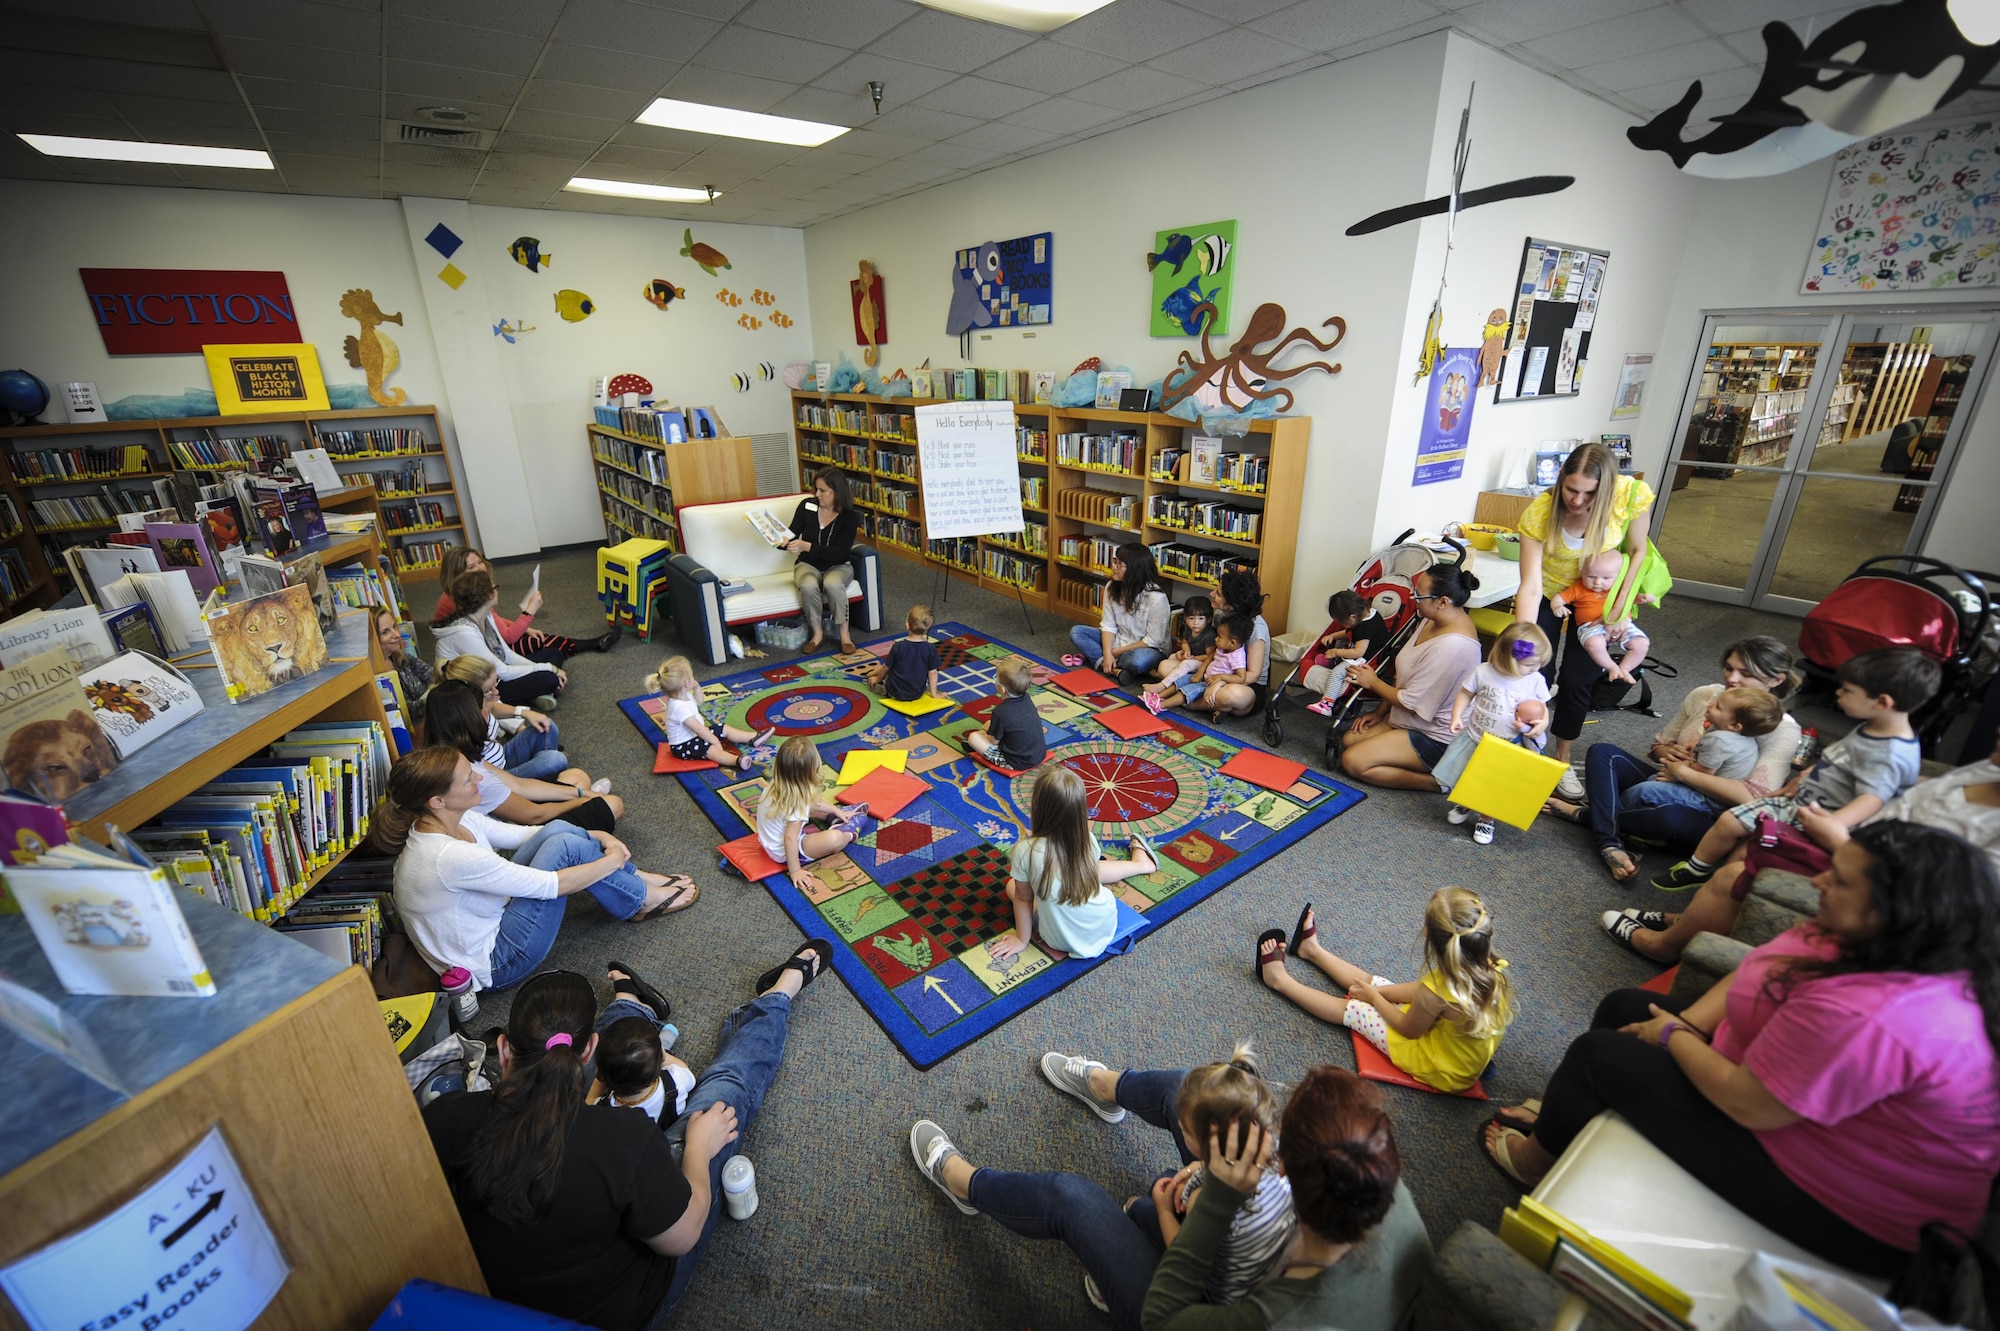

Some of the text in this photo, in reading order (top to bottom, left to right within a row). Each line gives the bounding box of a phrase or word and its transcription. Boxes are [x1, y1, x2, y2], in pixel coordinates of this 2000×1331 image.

[1000, 240, 1031, 258] READ
[1010, 273, 1050, 290] BOOKS
[89, 293, 296, 326] FICTION
[235, 363, 295, 372] CELEBRATE
[1438, 355, 1457, 376] Spanish
[1458, 354, 1470, 365] Story
[249, 372, 288, 380] BLACK
[251, 380, 296, 389] HISTORY
[252, 388, 292, 397] MONTH
[936, 416, 955, 428] Hello
[959, 414, 992, 431] Everybody
[0, 618, 84, 650] Library Lion
[8, 666, 32, 681] THE
[31, 662, 72, 690] LION
[786, 695, 804, 704] 50
[815, 716, 833, 725] 50
[1270, 808, 1304, 830] ALLIGATOR
[1158, 878, 1187, 896] CAMEL
[824, 907, 854, 936] GIRAFFE
[866, 951, 890, 974] FROG
[995, 957, 1048, 992] ELEPHANT
[148, 1213, 168, 1234] A
[186, 1164, 217, 1200] KU
[78, 1214, 240, 1331] Easy Reader
[140, 1266, 222, 1331] Books
